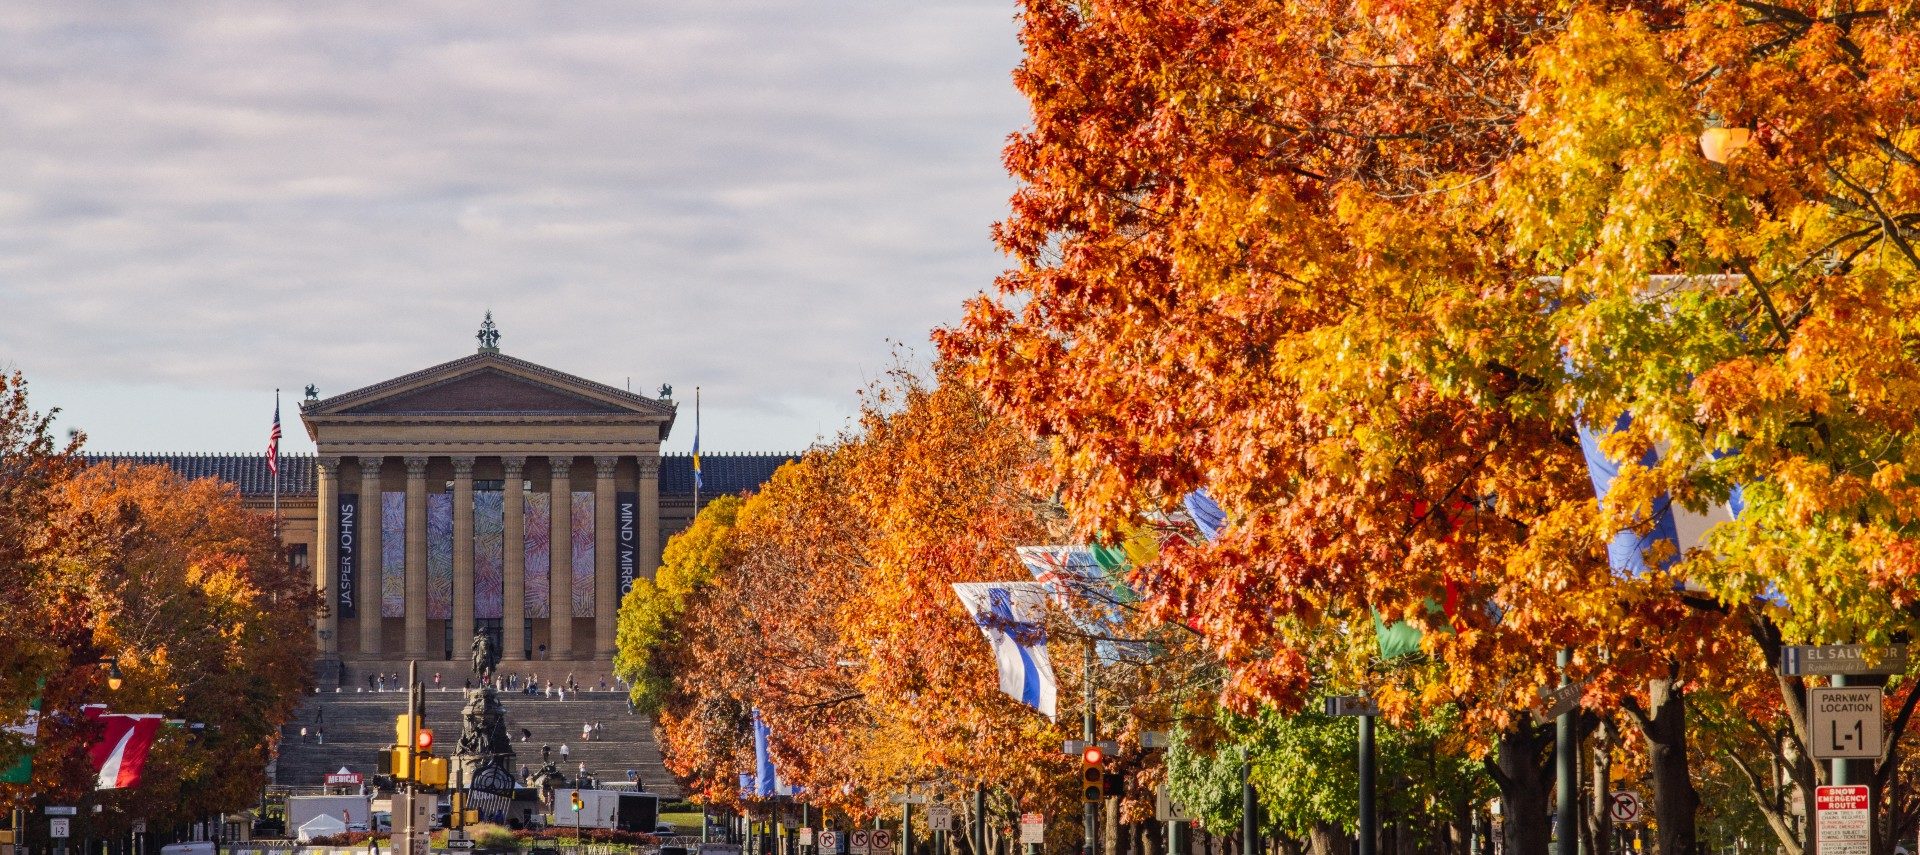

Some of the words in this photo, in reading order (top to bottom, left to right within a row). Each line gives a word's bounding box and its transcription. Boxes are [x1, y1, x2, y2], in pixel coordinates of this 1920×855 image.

[621, 503, 633, 541] MIND
[341, 504, 354, 554] JOHNS
[621, 550, 633, 595] MIRRO
[341, 556, 353, 608] JASPER
[1807, 649, 1824, 660] EL
[1828, 647, 1898, 660] SALVOR
[1822, 693, 1871, 703] PARKWAY
[1820, 703, 1873, 713] LOCATION
[1831, 719, 1863, 751] L-1
[328, 774, 360, 784] MEDICAL
[1818, 795, 1867, 803] EMERGENCY
[934, 817, 946, 829] J-1
